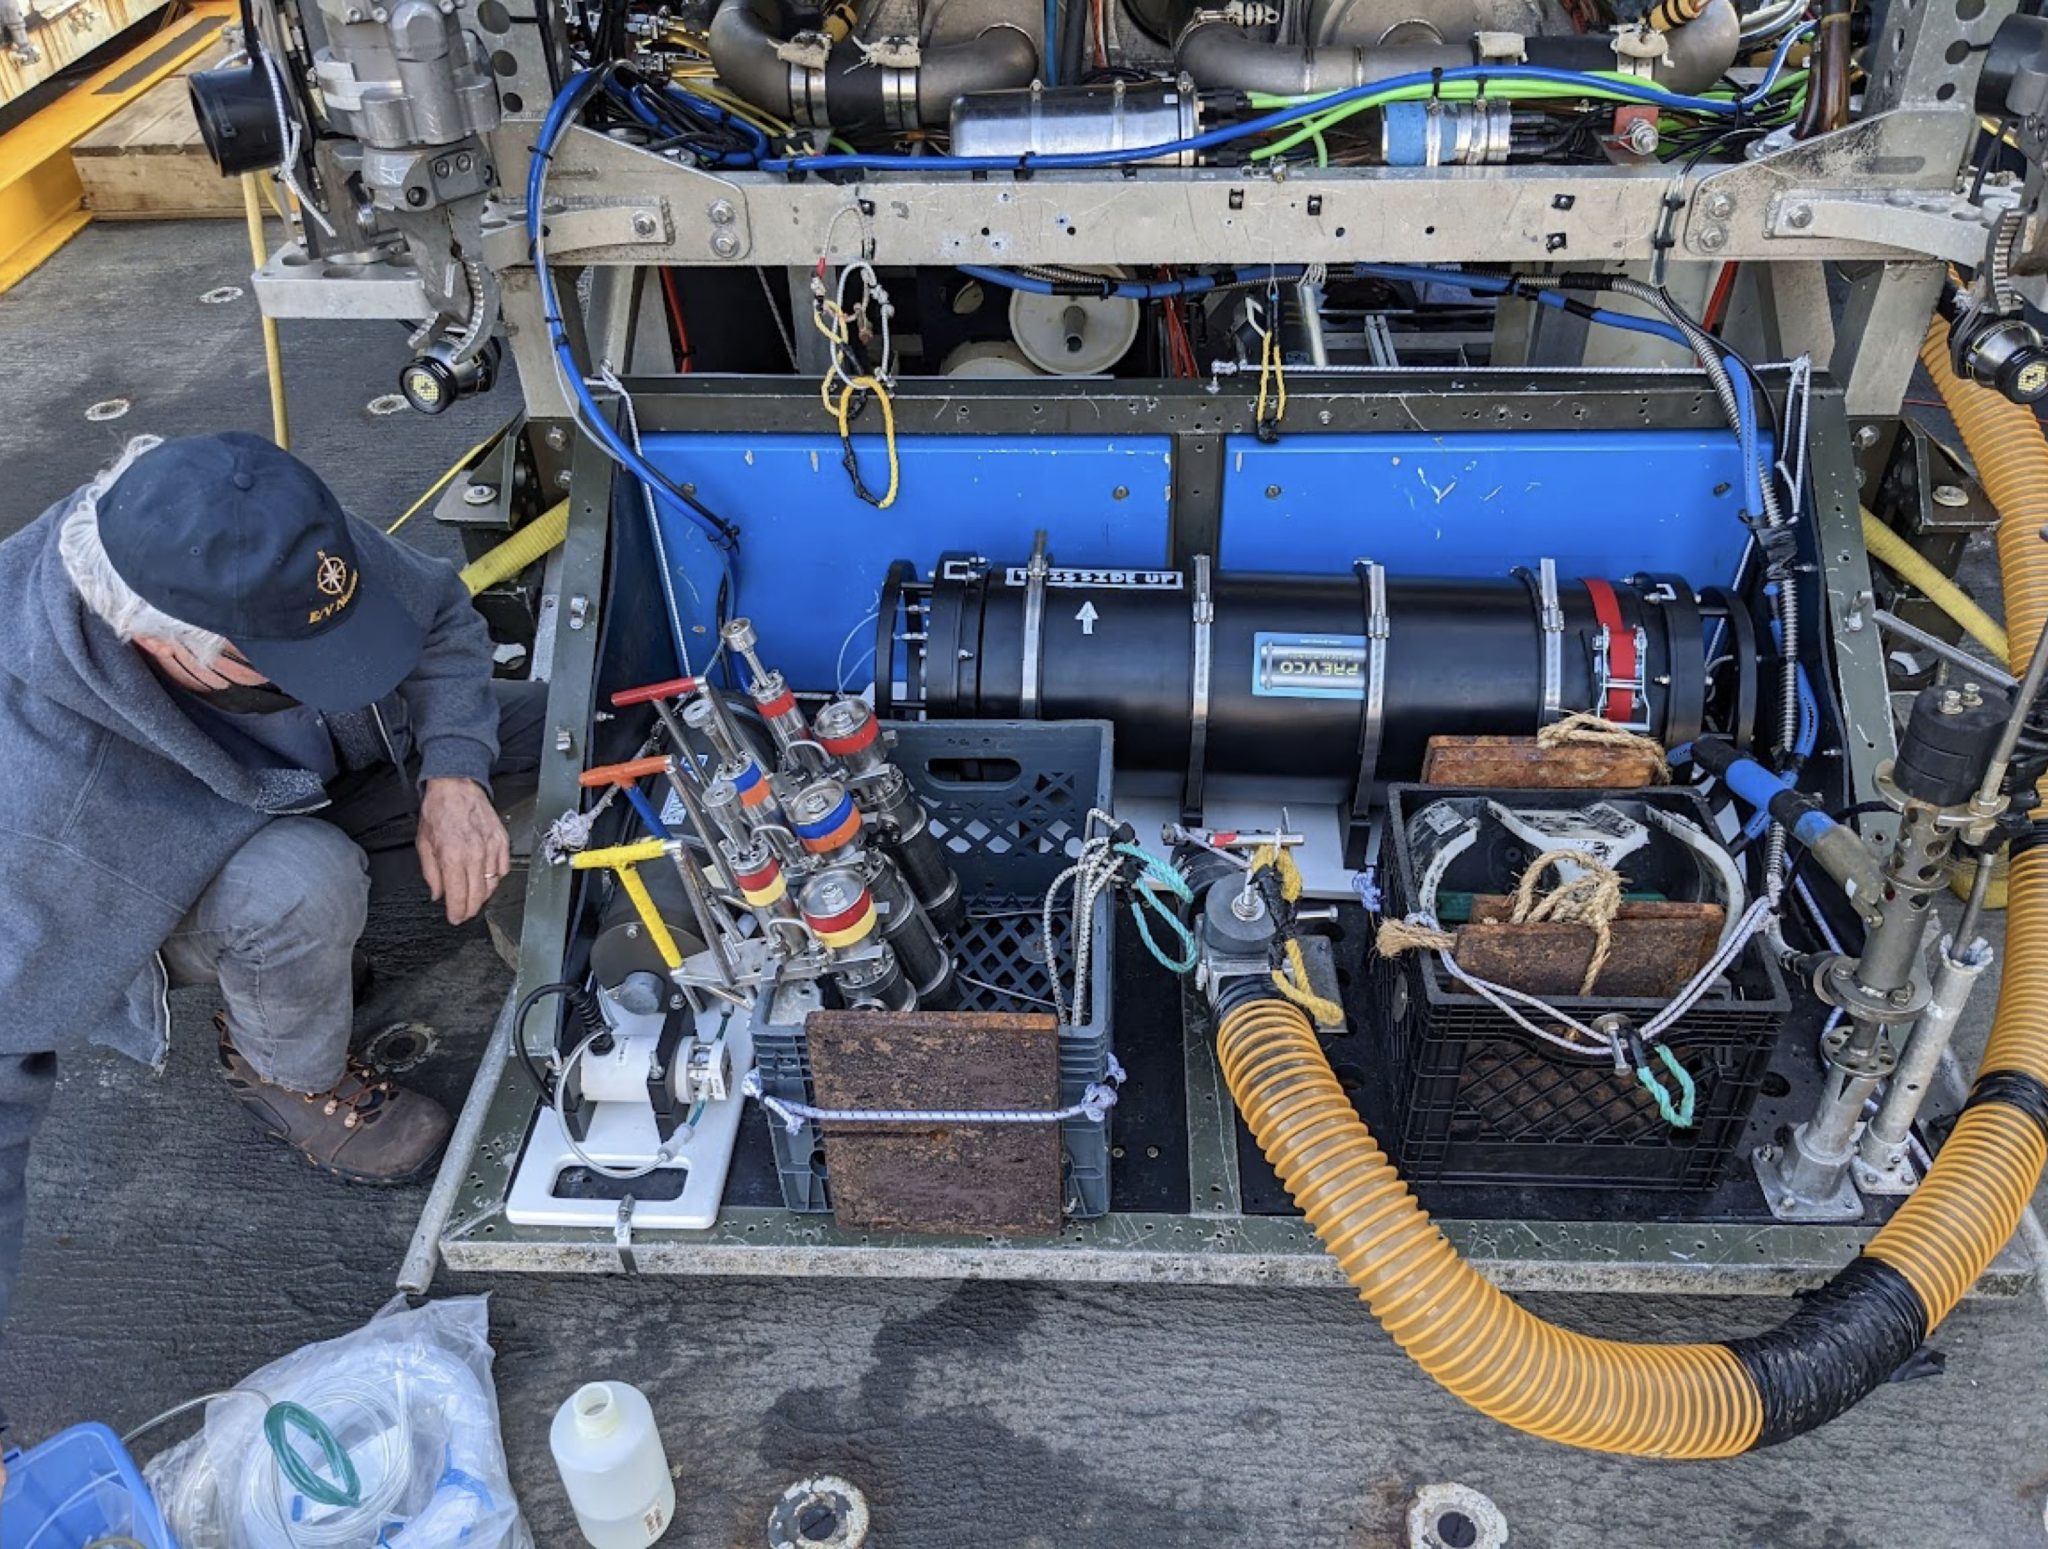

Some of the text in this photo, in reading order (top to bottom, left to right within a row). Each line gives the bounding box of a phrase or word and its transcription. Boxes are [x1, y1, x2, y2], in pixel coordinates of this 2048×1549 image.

[1017, 572, 1174, 584] TIS SIDE UP
[1280, 662, 1358, 676] PREVCO
